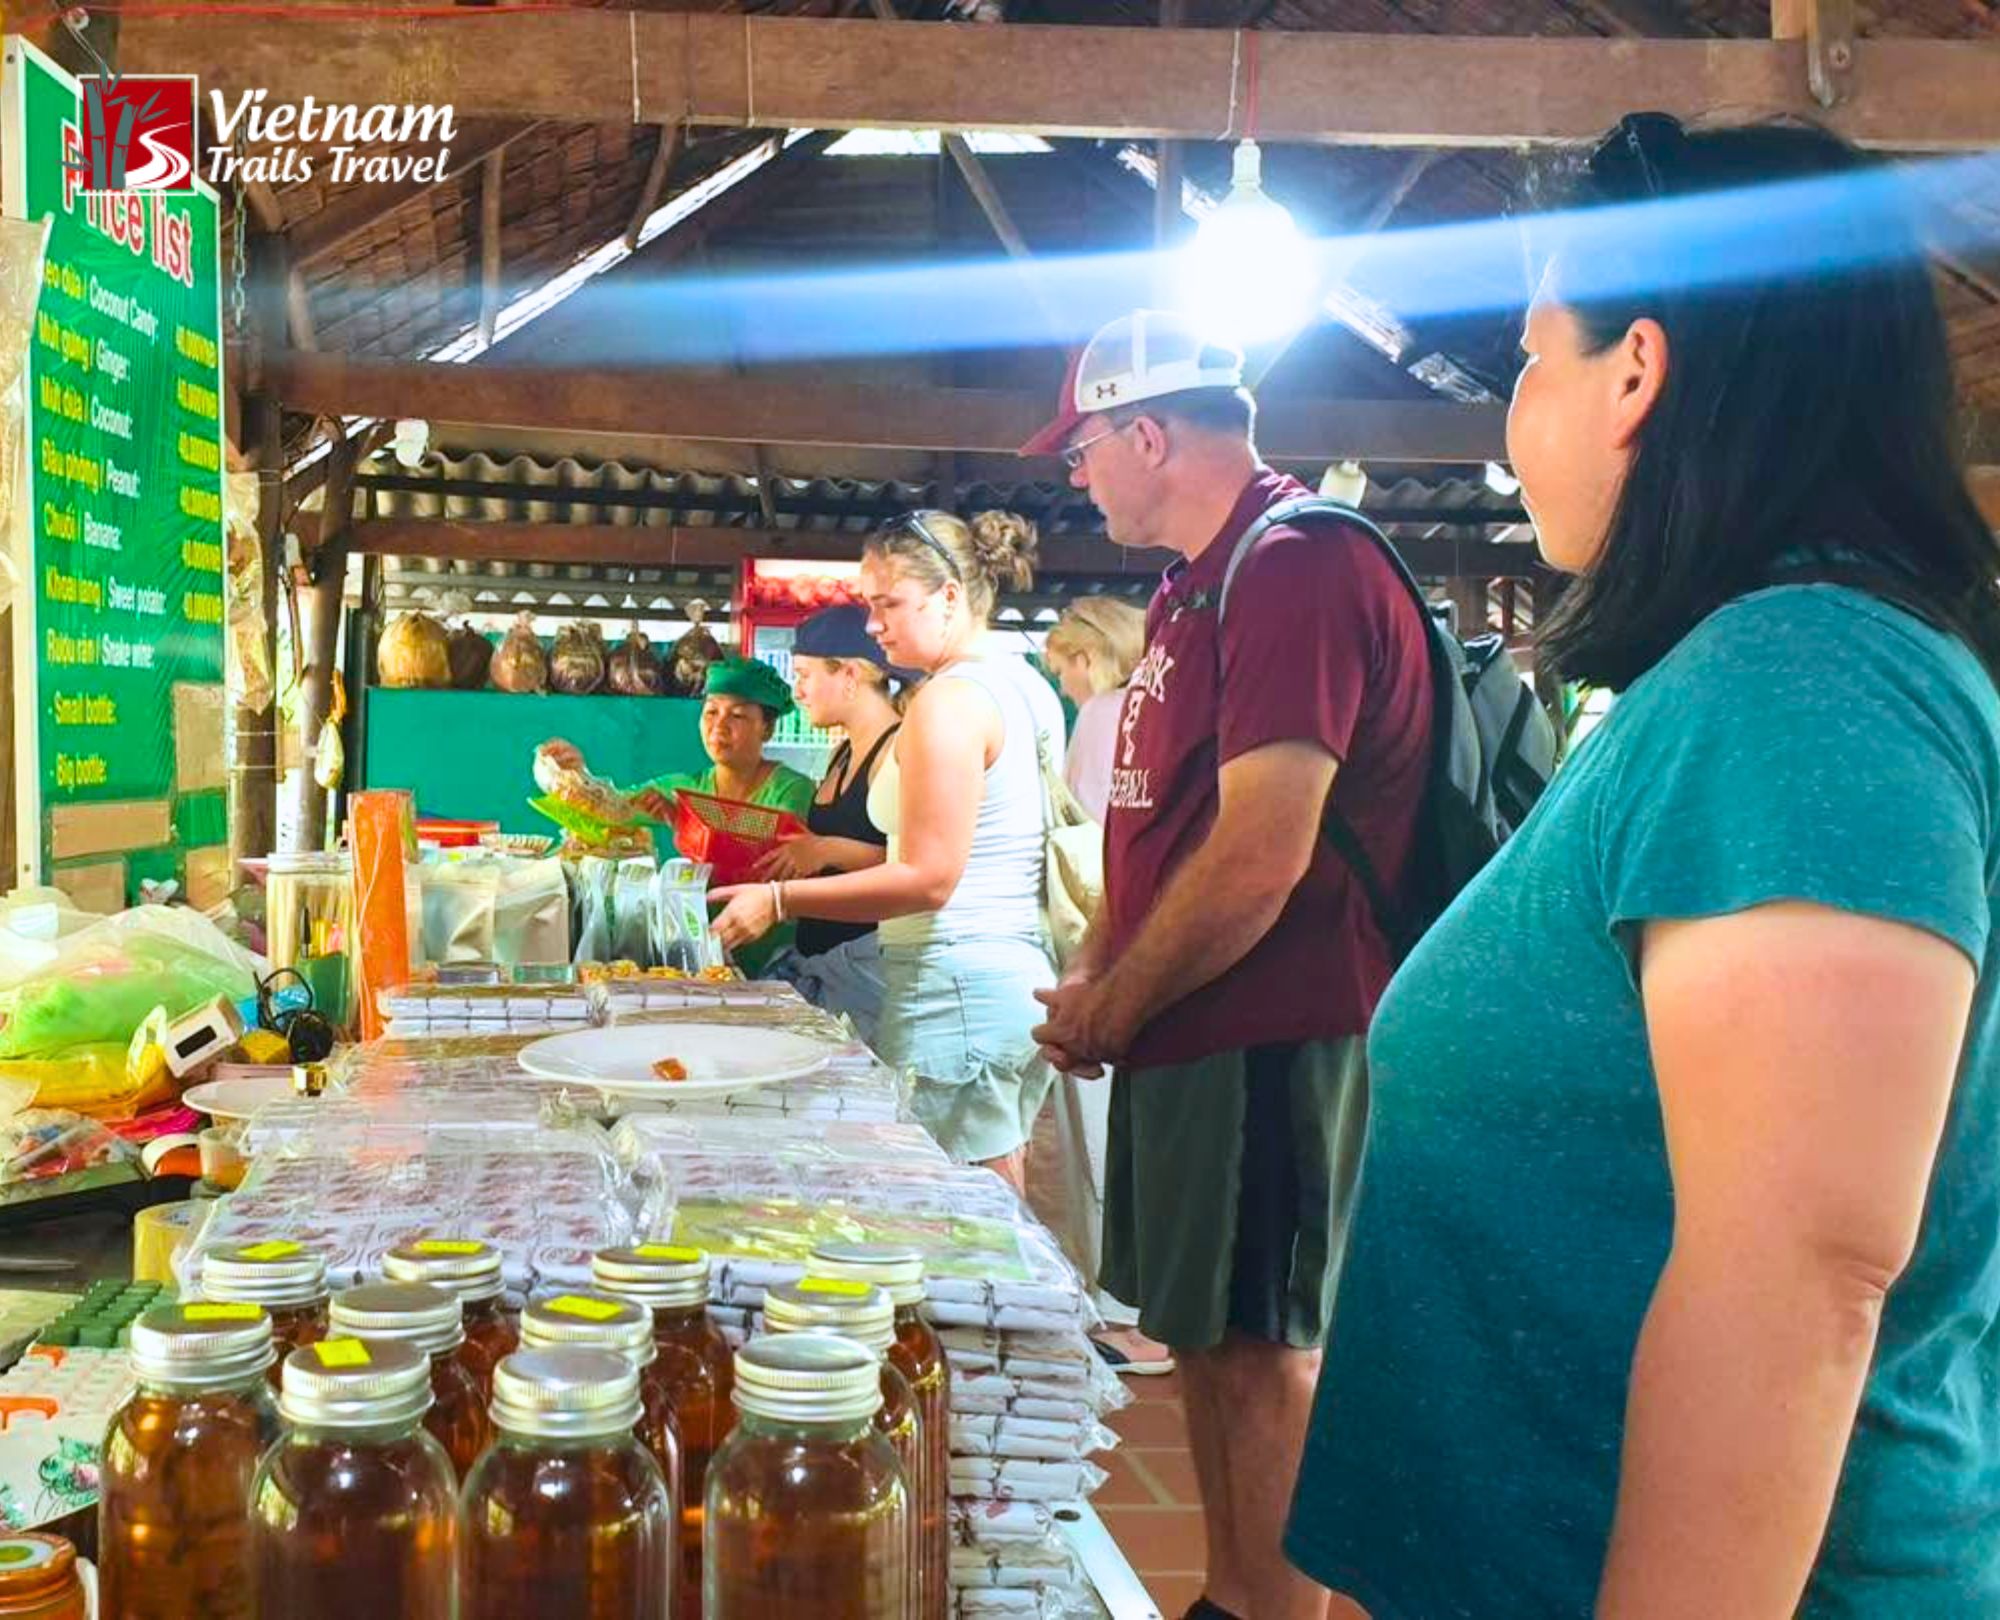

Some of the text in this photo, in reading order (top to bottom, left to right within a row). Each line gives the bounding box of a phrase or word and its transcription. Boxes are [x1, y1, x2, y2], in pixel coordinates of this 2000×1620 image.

[90, 274, 129, 324] Coconut
[108, 576, 135, 611] Sweet
[102, 633, 130, 667] Snake
[57, 752, 75, 794] Big
